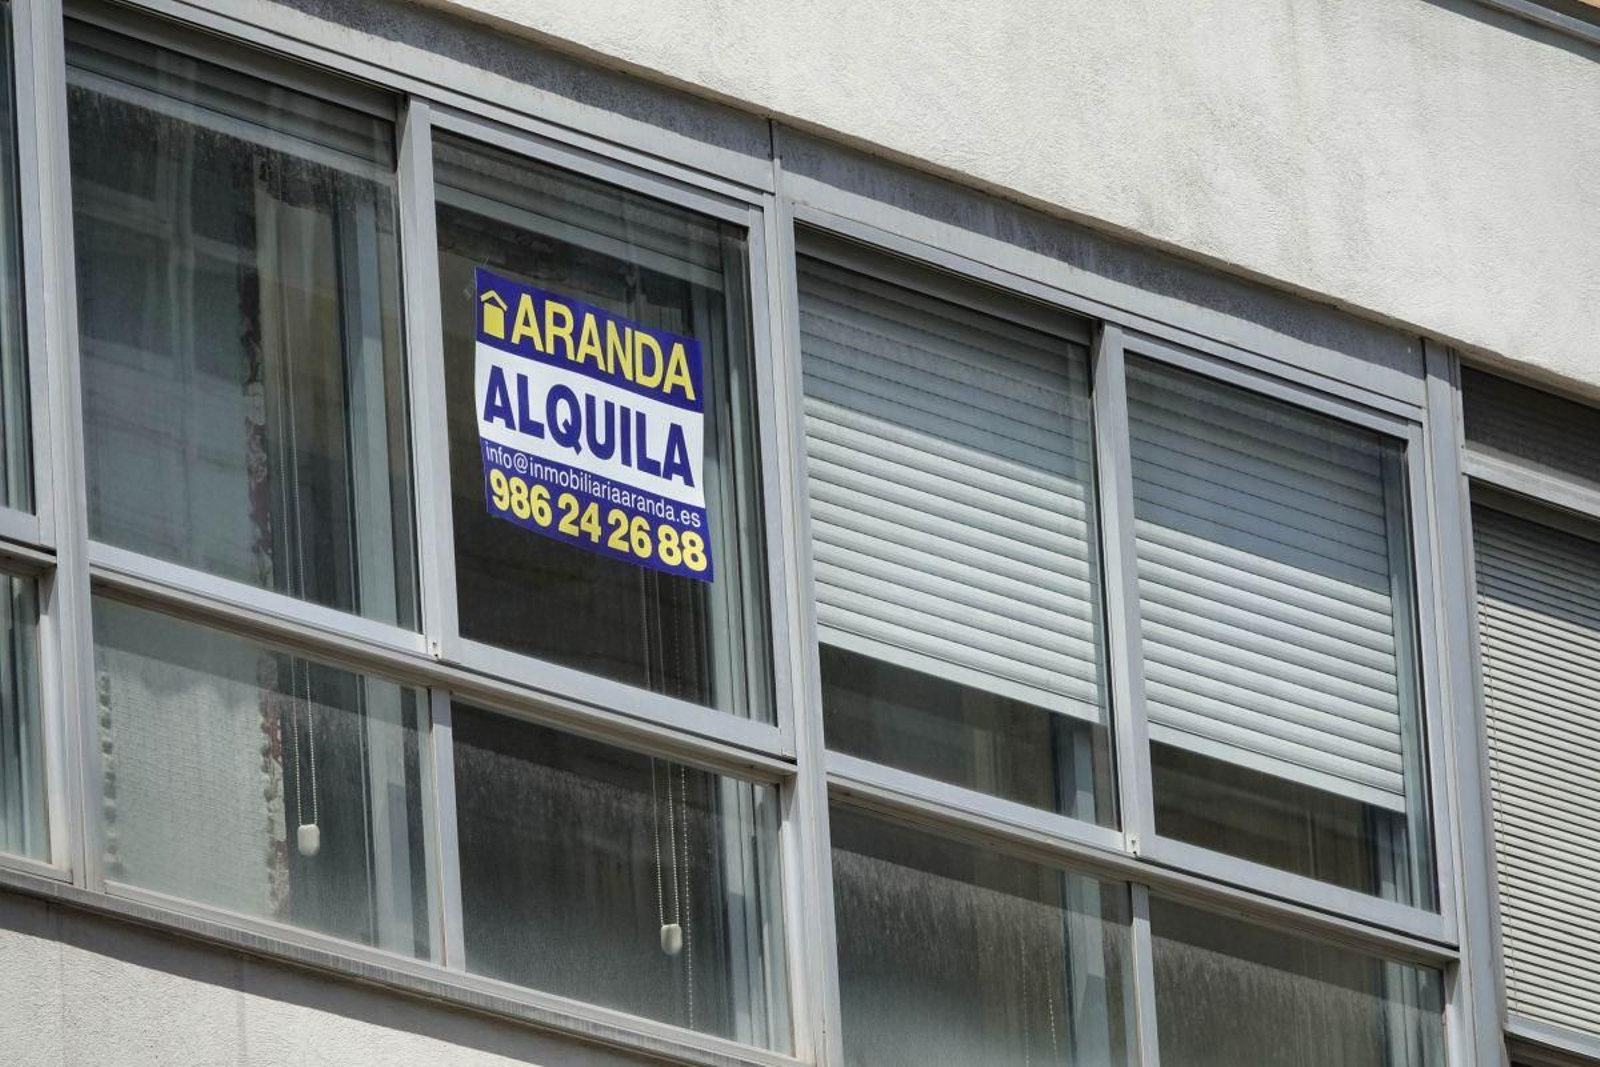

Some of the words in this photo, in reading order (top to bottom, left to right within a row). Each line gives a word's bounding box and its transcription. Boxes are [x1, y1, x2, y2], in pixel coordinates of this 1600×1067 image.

[511, 293, 696, 401] ARANDA
[483, 364, 695, 488] ALQUILA
[485, 441, 701, 528] info@inmobiliariaaranda.es
[489, 468, 553, 527] 986
[558, 493, 602, 543] 24
[607, 508, 653, 559] 26
[657, 524, 708, 572] 88
